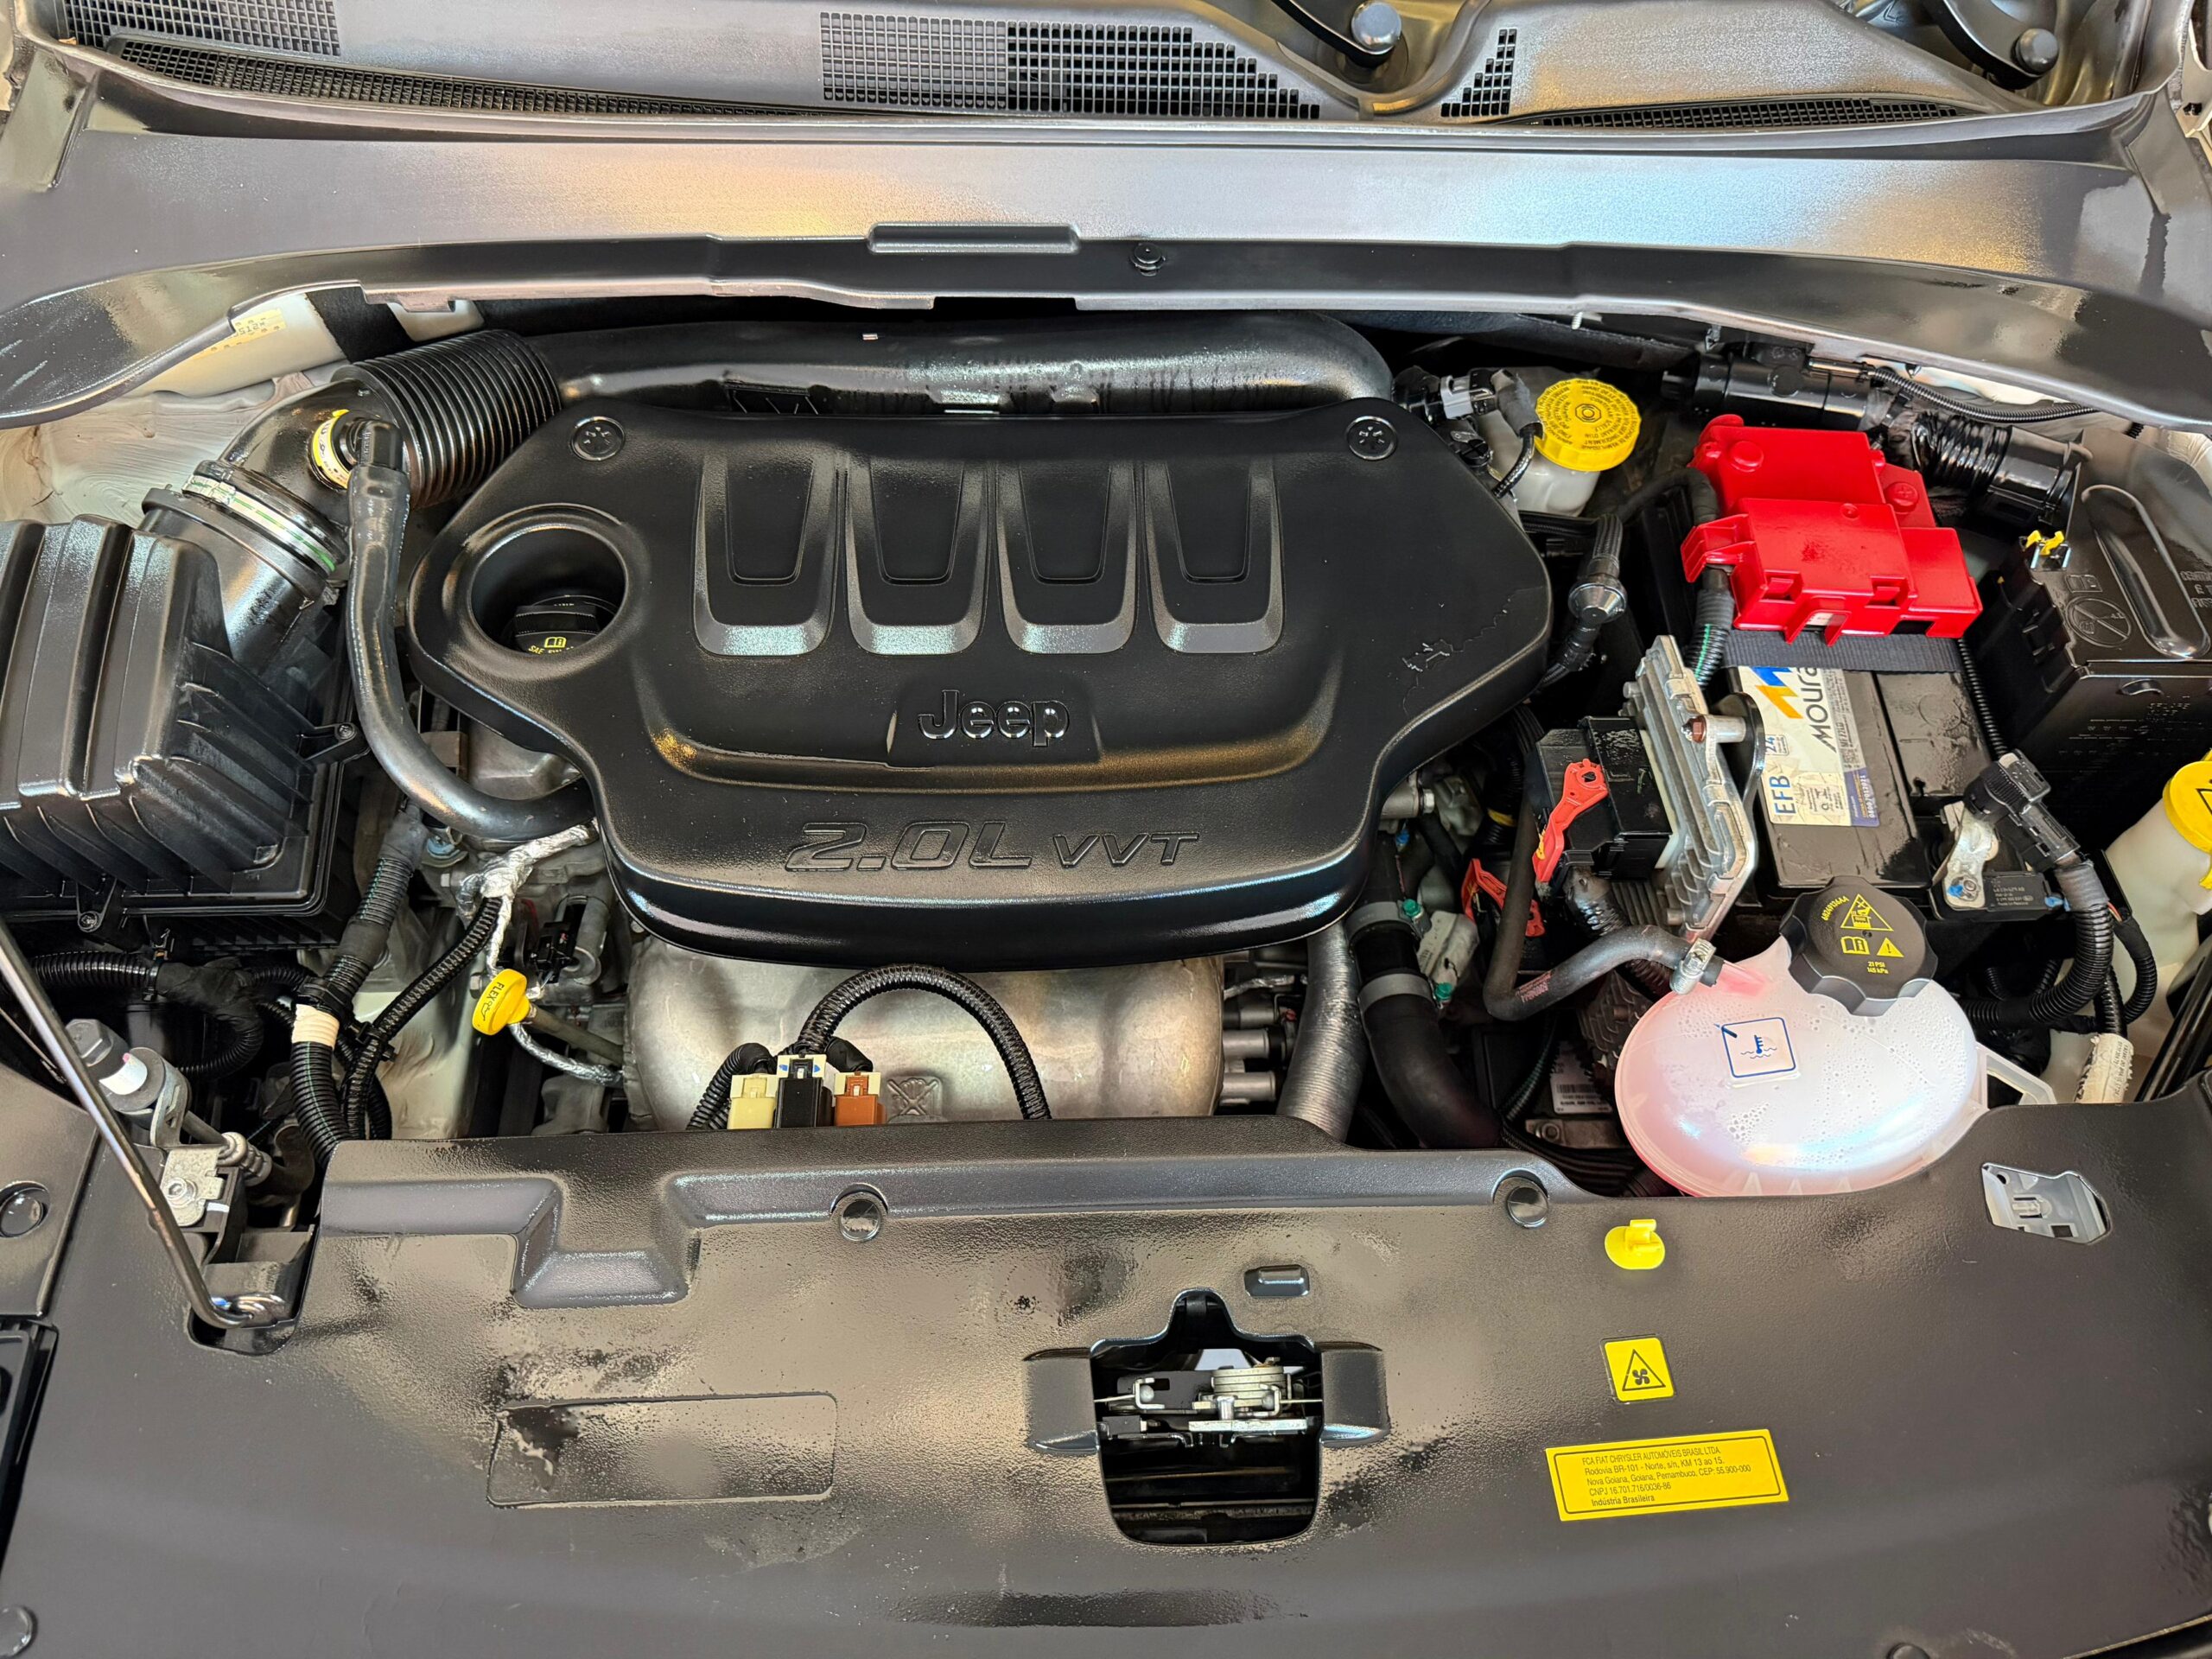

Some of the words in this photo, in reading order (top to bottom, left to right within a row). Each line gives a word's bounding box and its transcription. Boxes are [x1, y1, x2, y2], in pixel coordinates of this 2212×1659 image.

[918, 690, 1071, 747] Jeep
[1769, 775, 1796, 815] EFB
[785, 821, 1033, 872] 2.0L
[1052, 832, 1200, 867] VVT
[486, 982, 505, 1001] FLEX
[1596, 1456, 1607, 1465] FIAT
[1610, 1453, 1642, 1463] CHRYSLER
[1643, 1448, 1681, 1460] AUTOMÓVEIS
[1682, 1447, 1704, 1457] BRASIL
[1585, 1466, 1612, 1476] Rodovia
[1613, 1465, 1638, 1473] BR-101
[1586, 1478, 1604, 1486] Nova
[1605, 1476, 1630, 1484] Goiana,
[1630, 1473, 1656, 1482] Goiana,
[1698, 1467, 1715, 1476] CEP:
[1716, 1465, 1751, 1474] 55.900-000
[1589, 1487, 1608, 1497] CNPJ
[1592, 1497, 1622, 1507] Indústria
[1623, 1494, 1655, 1503] Brasileira
